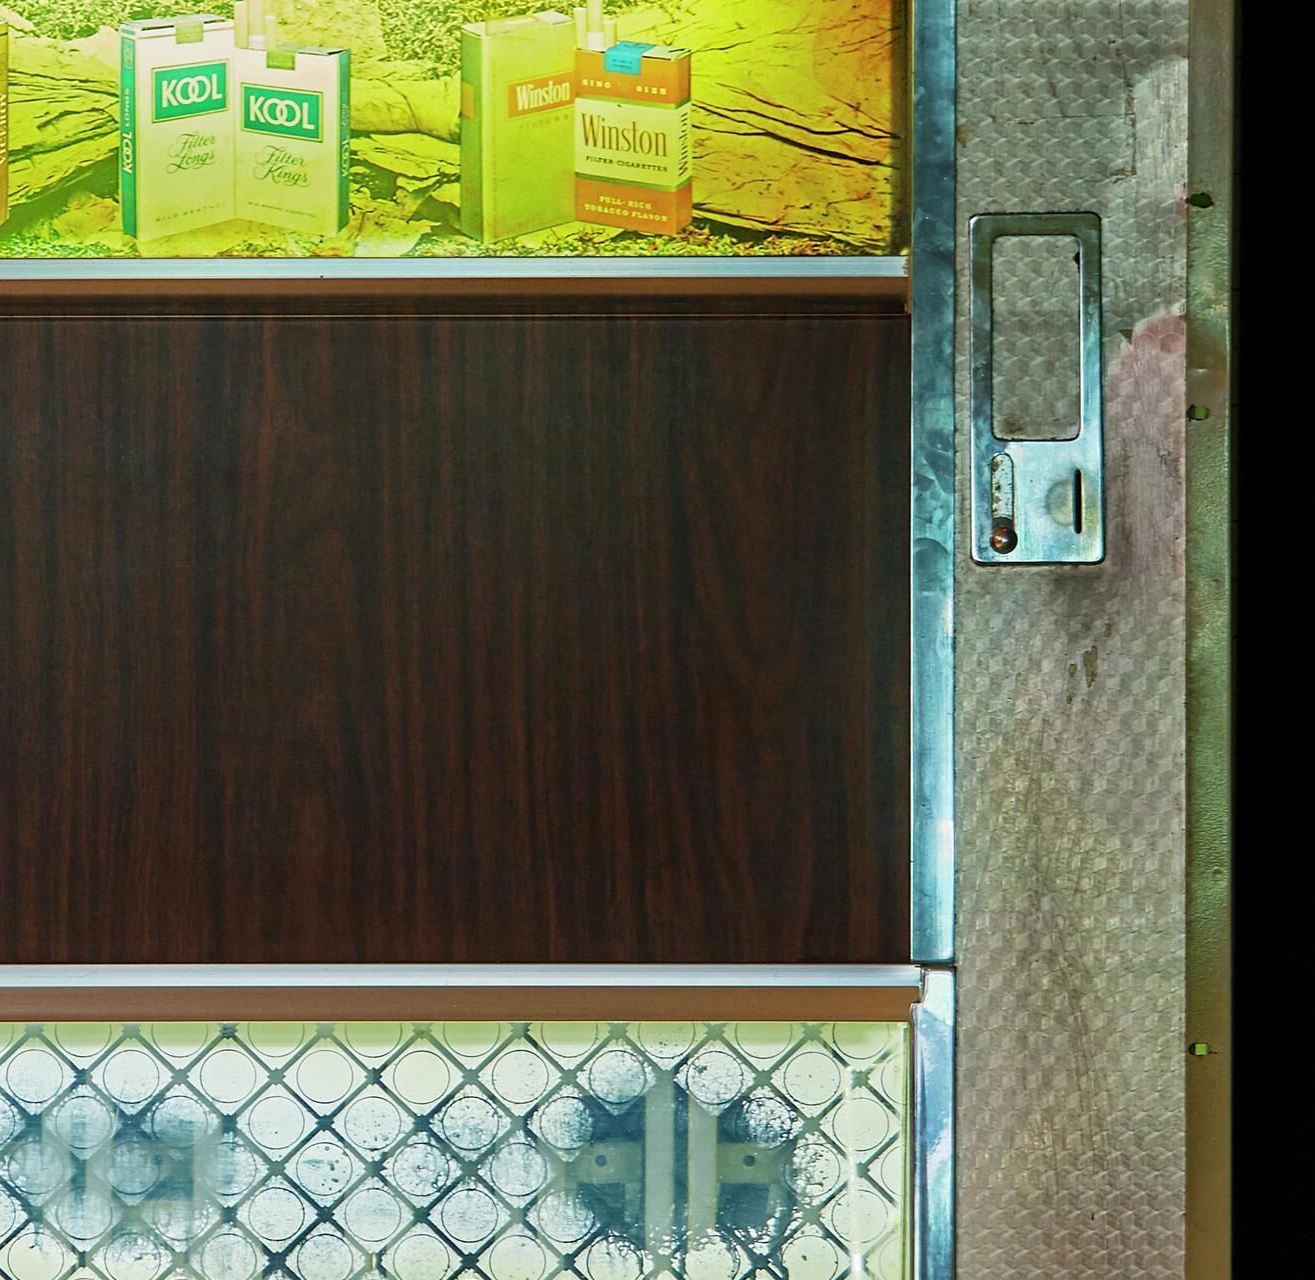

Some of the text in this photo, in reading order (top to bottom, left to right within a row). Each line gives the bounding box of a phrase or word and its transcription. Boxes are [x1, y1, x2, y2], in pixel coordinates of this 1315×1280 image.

[161, 73, 222, 108] KOOL
[516, 80, 570, 112] Winston
[582, 79, 667, 95] KING SIZE
[249, 95, 315, 130] KOOL
[0, 93, 7, 165] VICEROY
[581, 113, 667, 157] Winston
[123, 132, 132, 174] KOOL
[168, 132, 215, 157] Filter
[255, 145, 305, 167] Filter
[167, 151, 215, 174] Longs
[253, 162, 309, 188] Kings
[584, 203, 668, 222] TOBACCO FLAVOR
